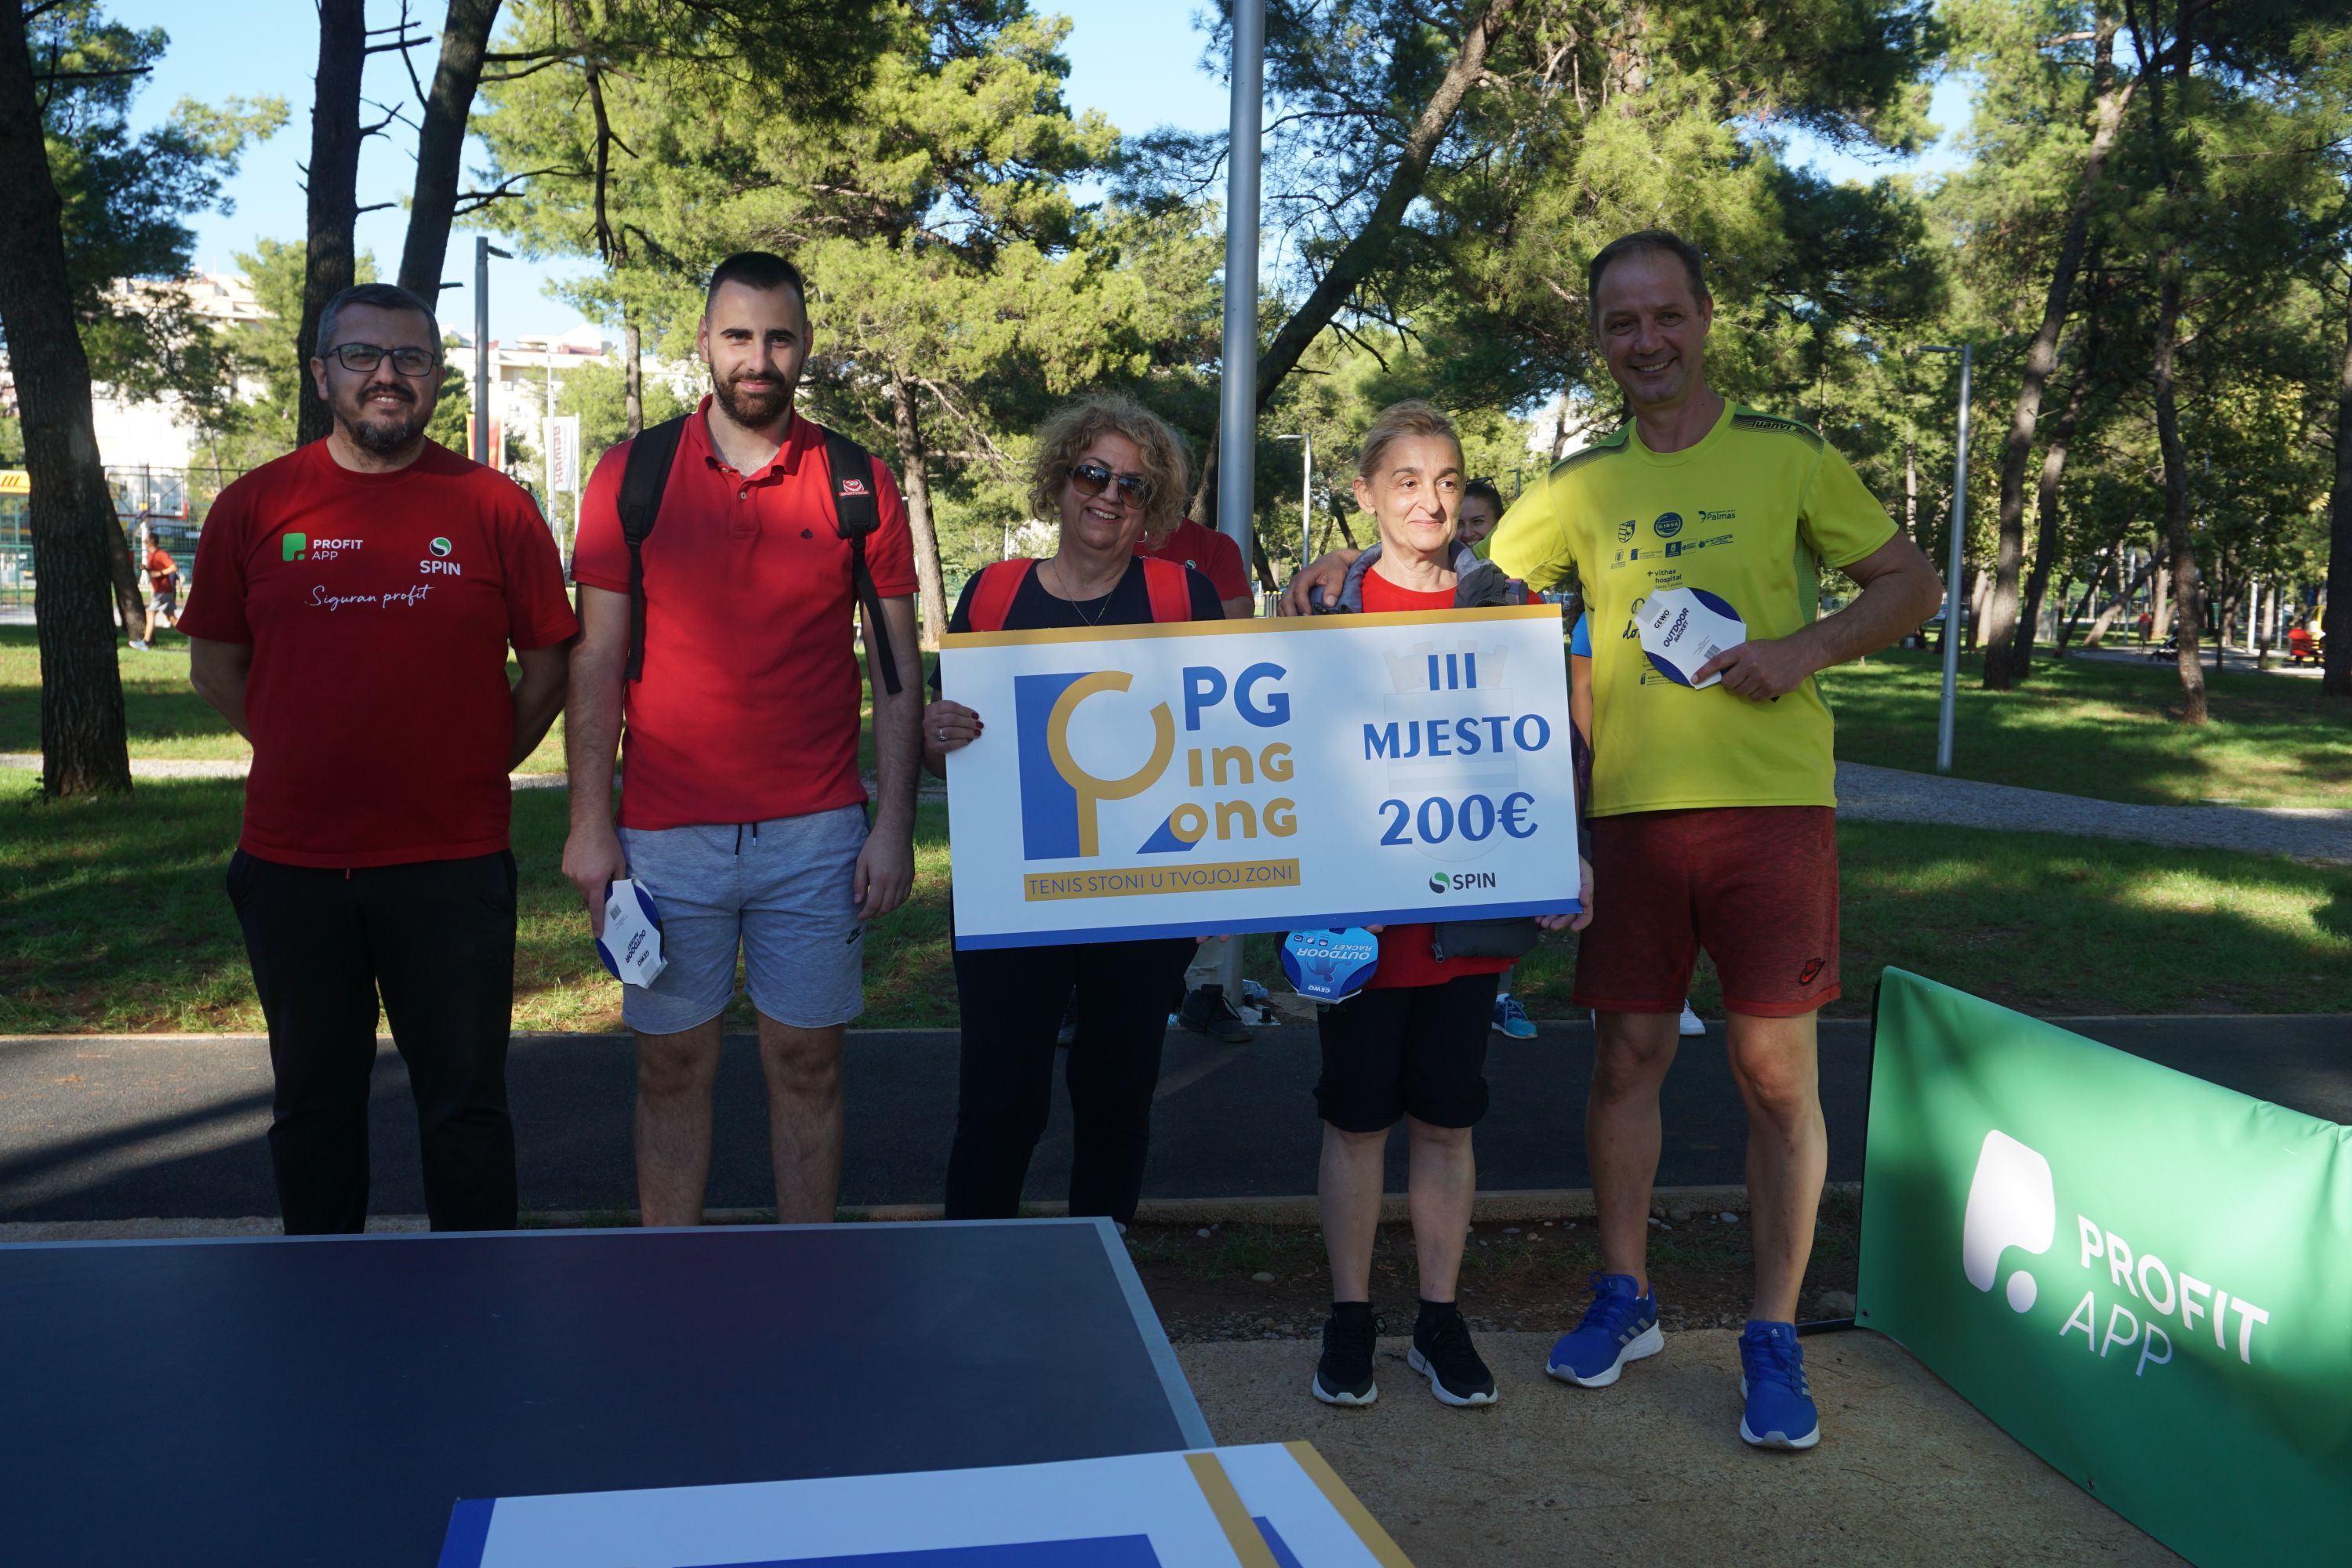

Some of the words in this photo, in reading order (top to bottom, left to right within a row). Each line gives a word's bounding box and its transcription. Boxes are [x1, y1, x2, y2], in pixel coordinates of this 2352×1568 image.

[311, 550, 338, 561] APP
[313, 539, 363, 550] PROFIT
[419, 560, 461, 576] SPIN
[1655, 573, 1682, 583] hospital
[306, 585, 377, 612] Siguran
[382, 583, 437, 608] profit
[1654, 609, 1670, 629] GEWO
[1663, 608, 1690, 648] OUTDOOR
[1674, 621, 1690, 643] RACKET
[1428, 652, 1477, 691] III
[1182, 662, 1290, 731] PG
[1363, 713, 1551, 760] MJESTO
[1378, 791, 1538, 846] 200€
[1029, 877, 1083, 895] TENIS
[1088, 873, 1145, 891] STONI
[1151, 873, 1163, 888] U
[1168, 868, 1240, 887] TVOJOJ
[1246, 865, 1292, 882] ZONI
[1453, 873, 1496, 891] SPIN
[625, 929, 647, 964] OUTDOOR
[1297, 948, 1370, 960] OUTDOOR
[2078, 1214, 2269, 1365] PROFIT
[2059, 1290, 2172, 1377] APP
